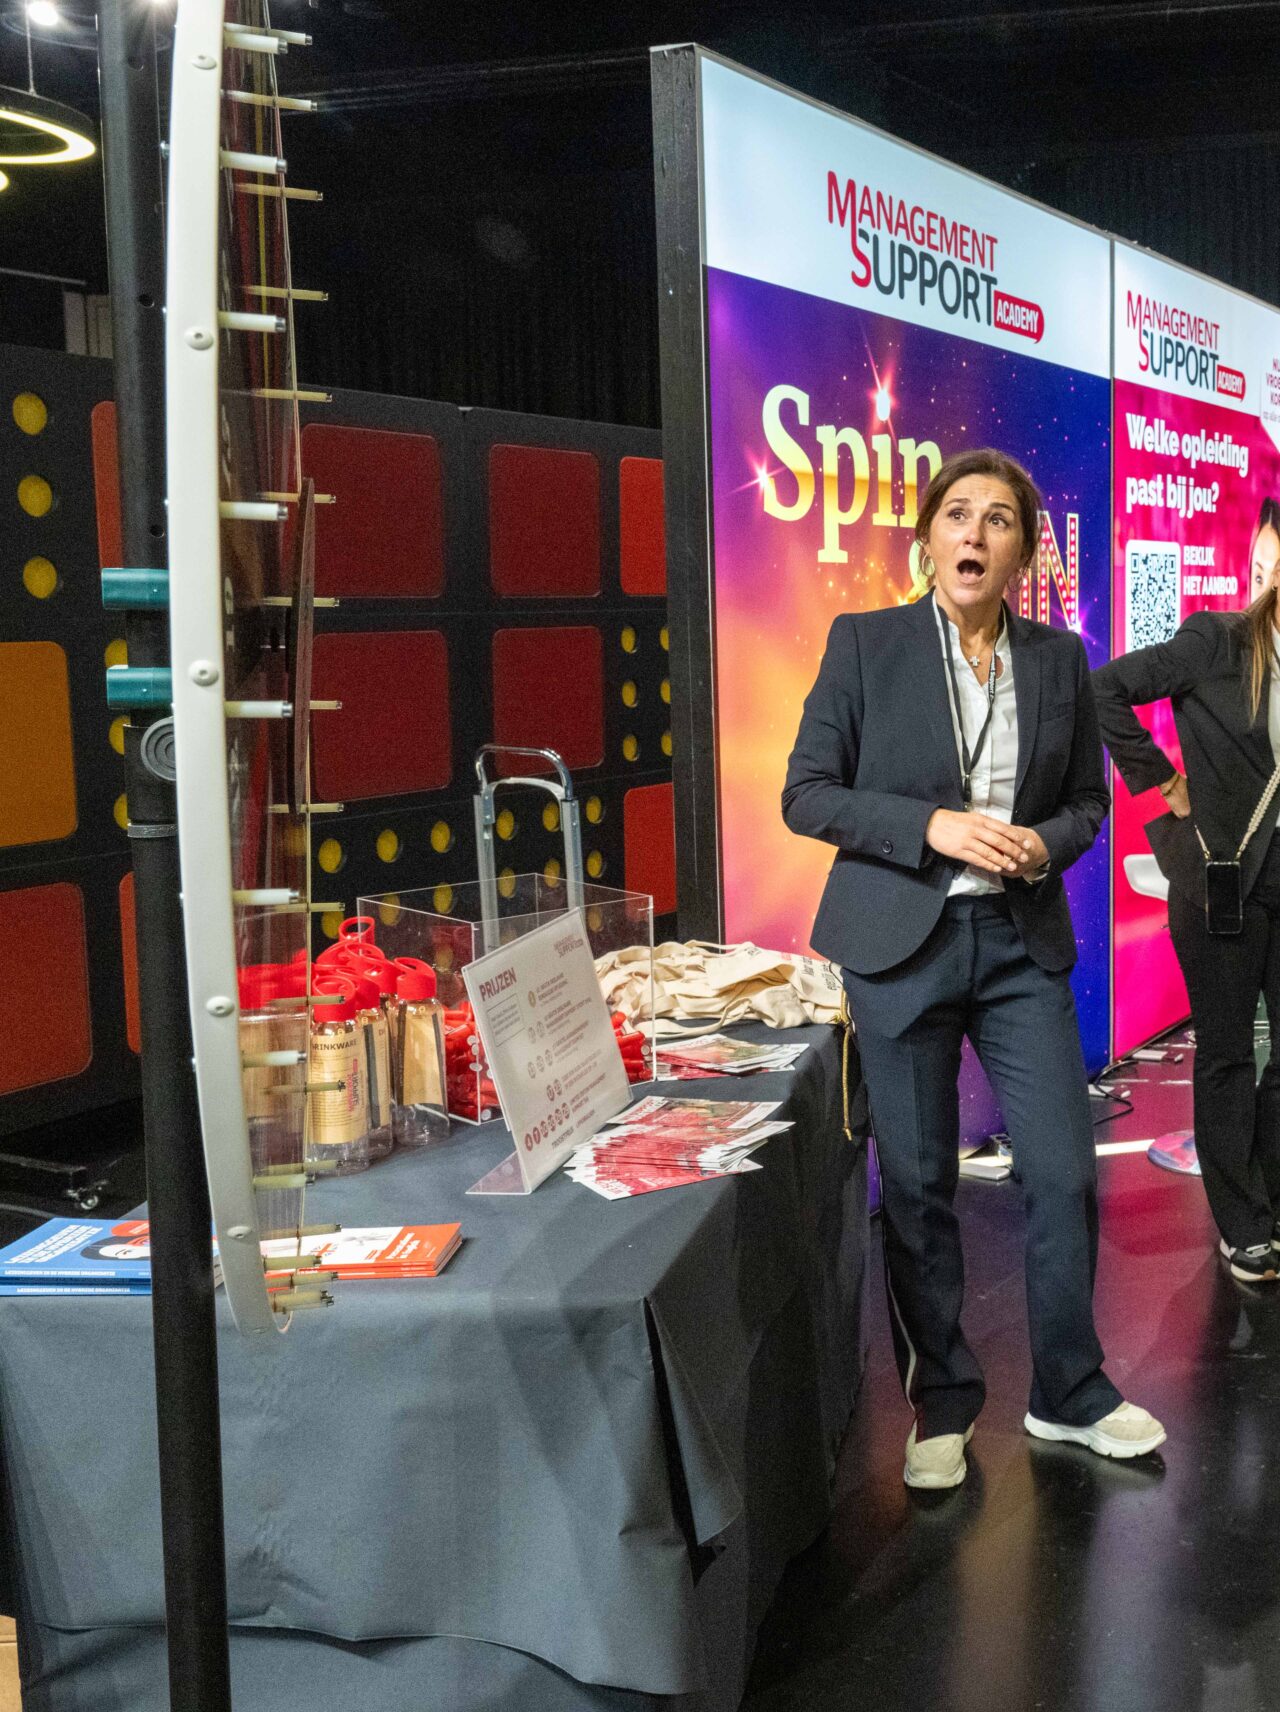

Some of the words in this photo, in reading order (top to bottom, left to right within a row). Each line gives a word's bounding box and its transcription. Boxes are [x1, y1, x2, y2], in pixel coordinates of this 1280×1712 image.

[828, 170, 998, 272] MANAGEMENT
[851, 227, 998, 326] SUPPORT
[996, 298, 1039, 333] ACADEMY
[1127, 290, 1220, 351] MANAGEMENT
[1138, 329, 1219, 392] SUPPORT
[1218, 371, 1243, 395] ACADEMY
[1126, 412, 1180, 457] Welke
[1181, 429, 1249, 478] opleiding
[762, 384, 943, 563] Spin
[1126, 473, 1164, 514] past
[1166, 473, 1187, 518] bij
[1187, 477, 1220, 519] jou?
[1183, 545, 1215, 566] BEKIJK
[1183, 576, 1202, 595] HET
[1202, 576, 1238, 596] AANBOD
[479, 967, 517, 1002] PRIJZEN
